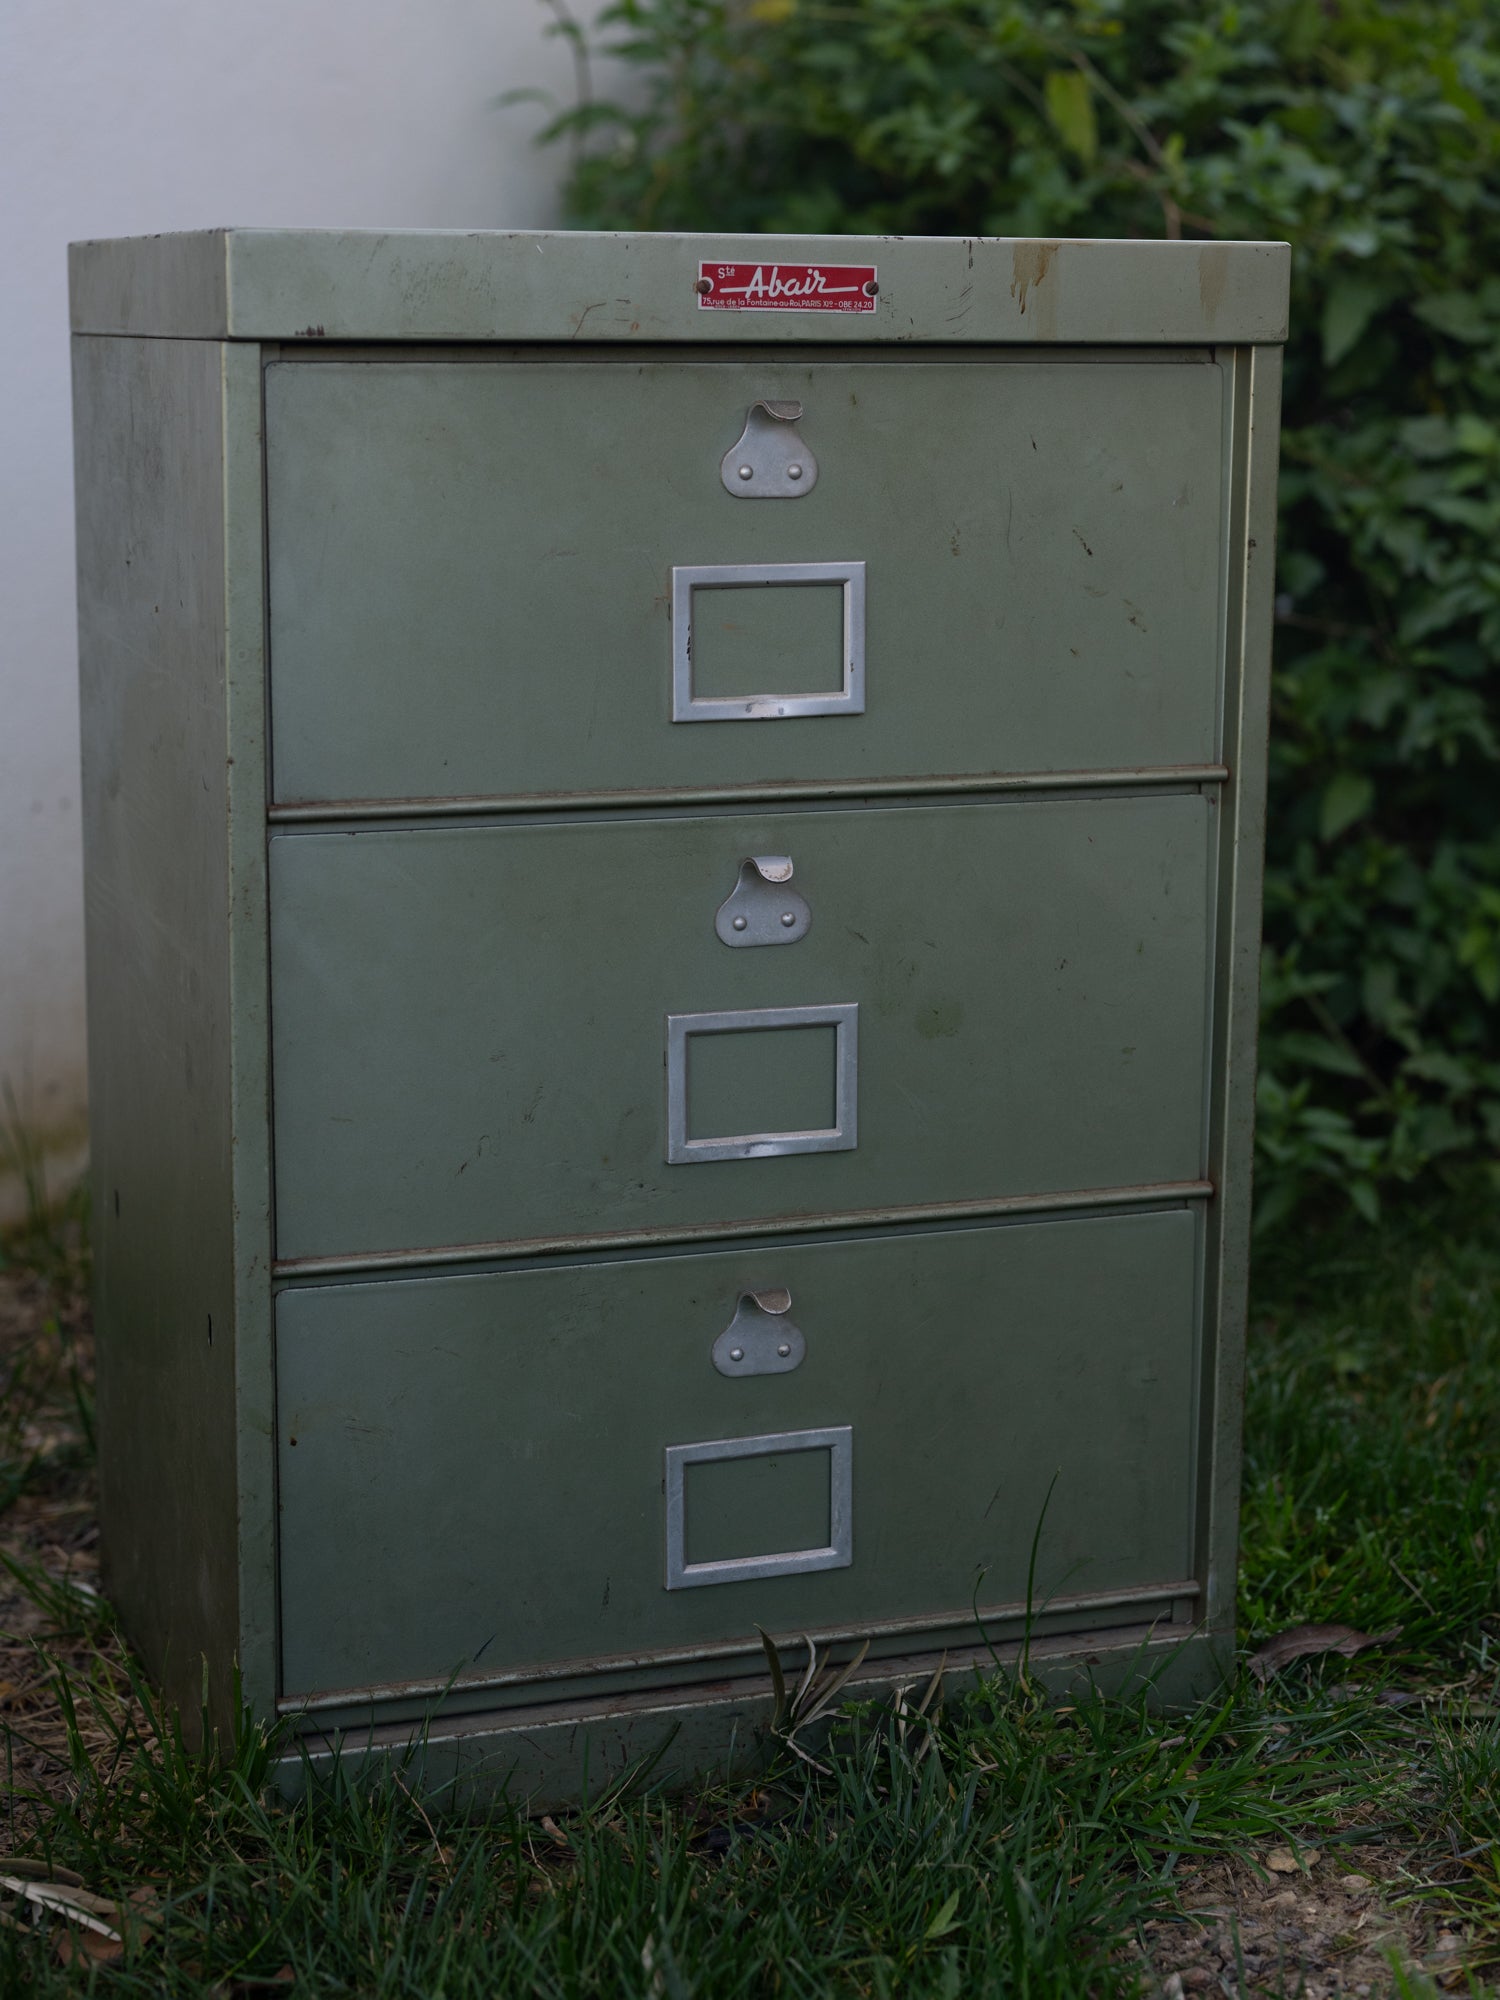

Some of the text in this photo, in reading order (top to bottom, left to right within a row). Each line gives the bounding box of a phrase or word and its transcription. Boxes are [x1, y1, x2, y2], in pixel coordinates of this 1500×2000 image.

[719, 266, 858, 299] Abair
[738, 298, 746, 306] la
[838, 300, 853, 309] OBE
[853, 300, 873, 309] 24.20
